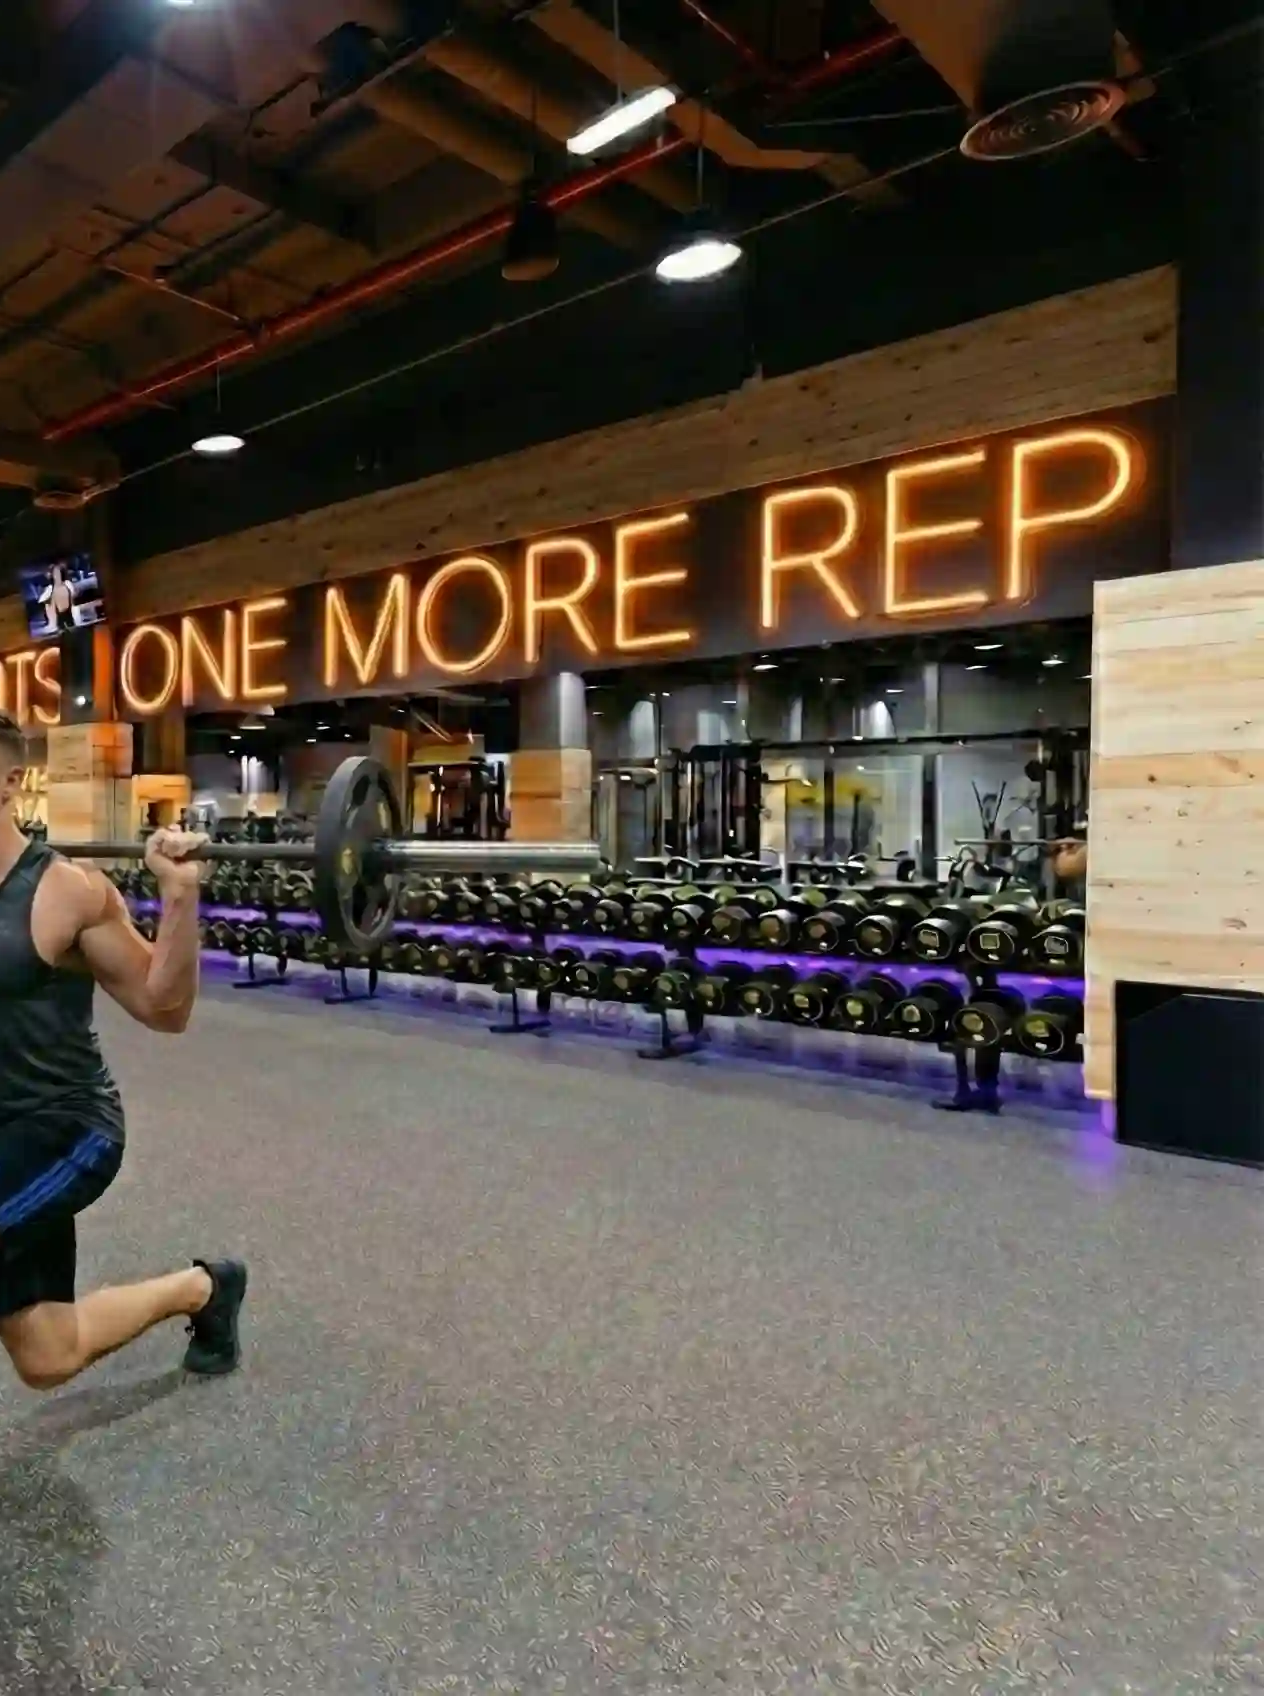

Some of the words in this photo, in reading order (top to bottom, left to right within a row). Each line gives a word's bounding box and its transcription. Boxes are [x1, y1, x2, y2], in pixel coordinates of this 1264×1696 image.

[120, 596, 287, 715] ONE
[324, 511, 691, 688] MORE
[760, 429, 1132, 629] REP
